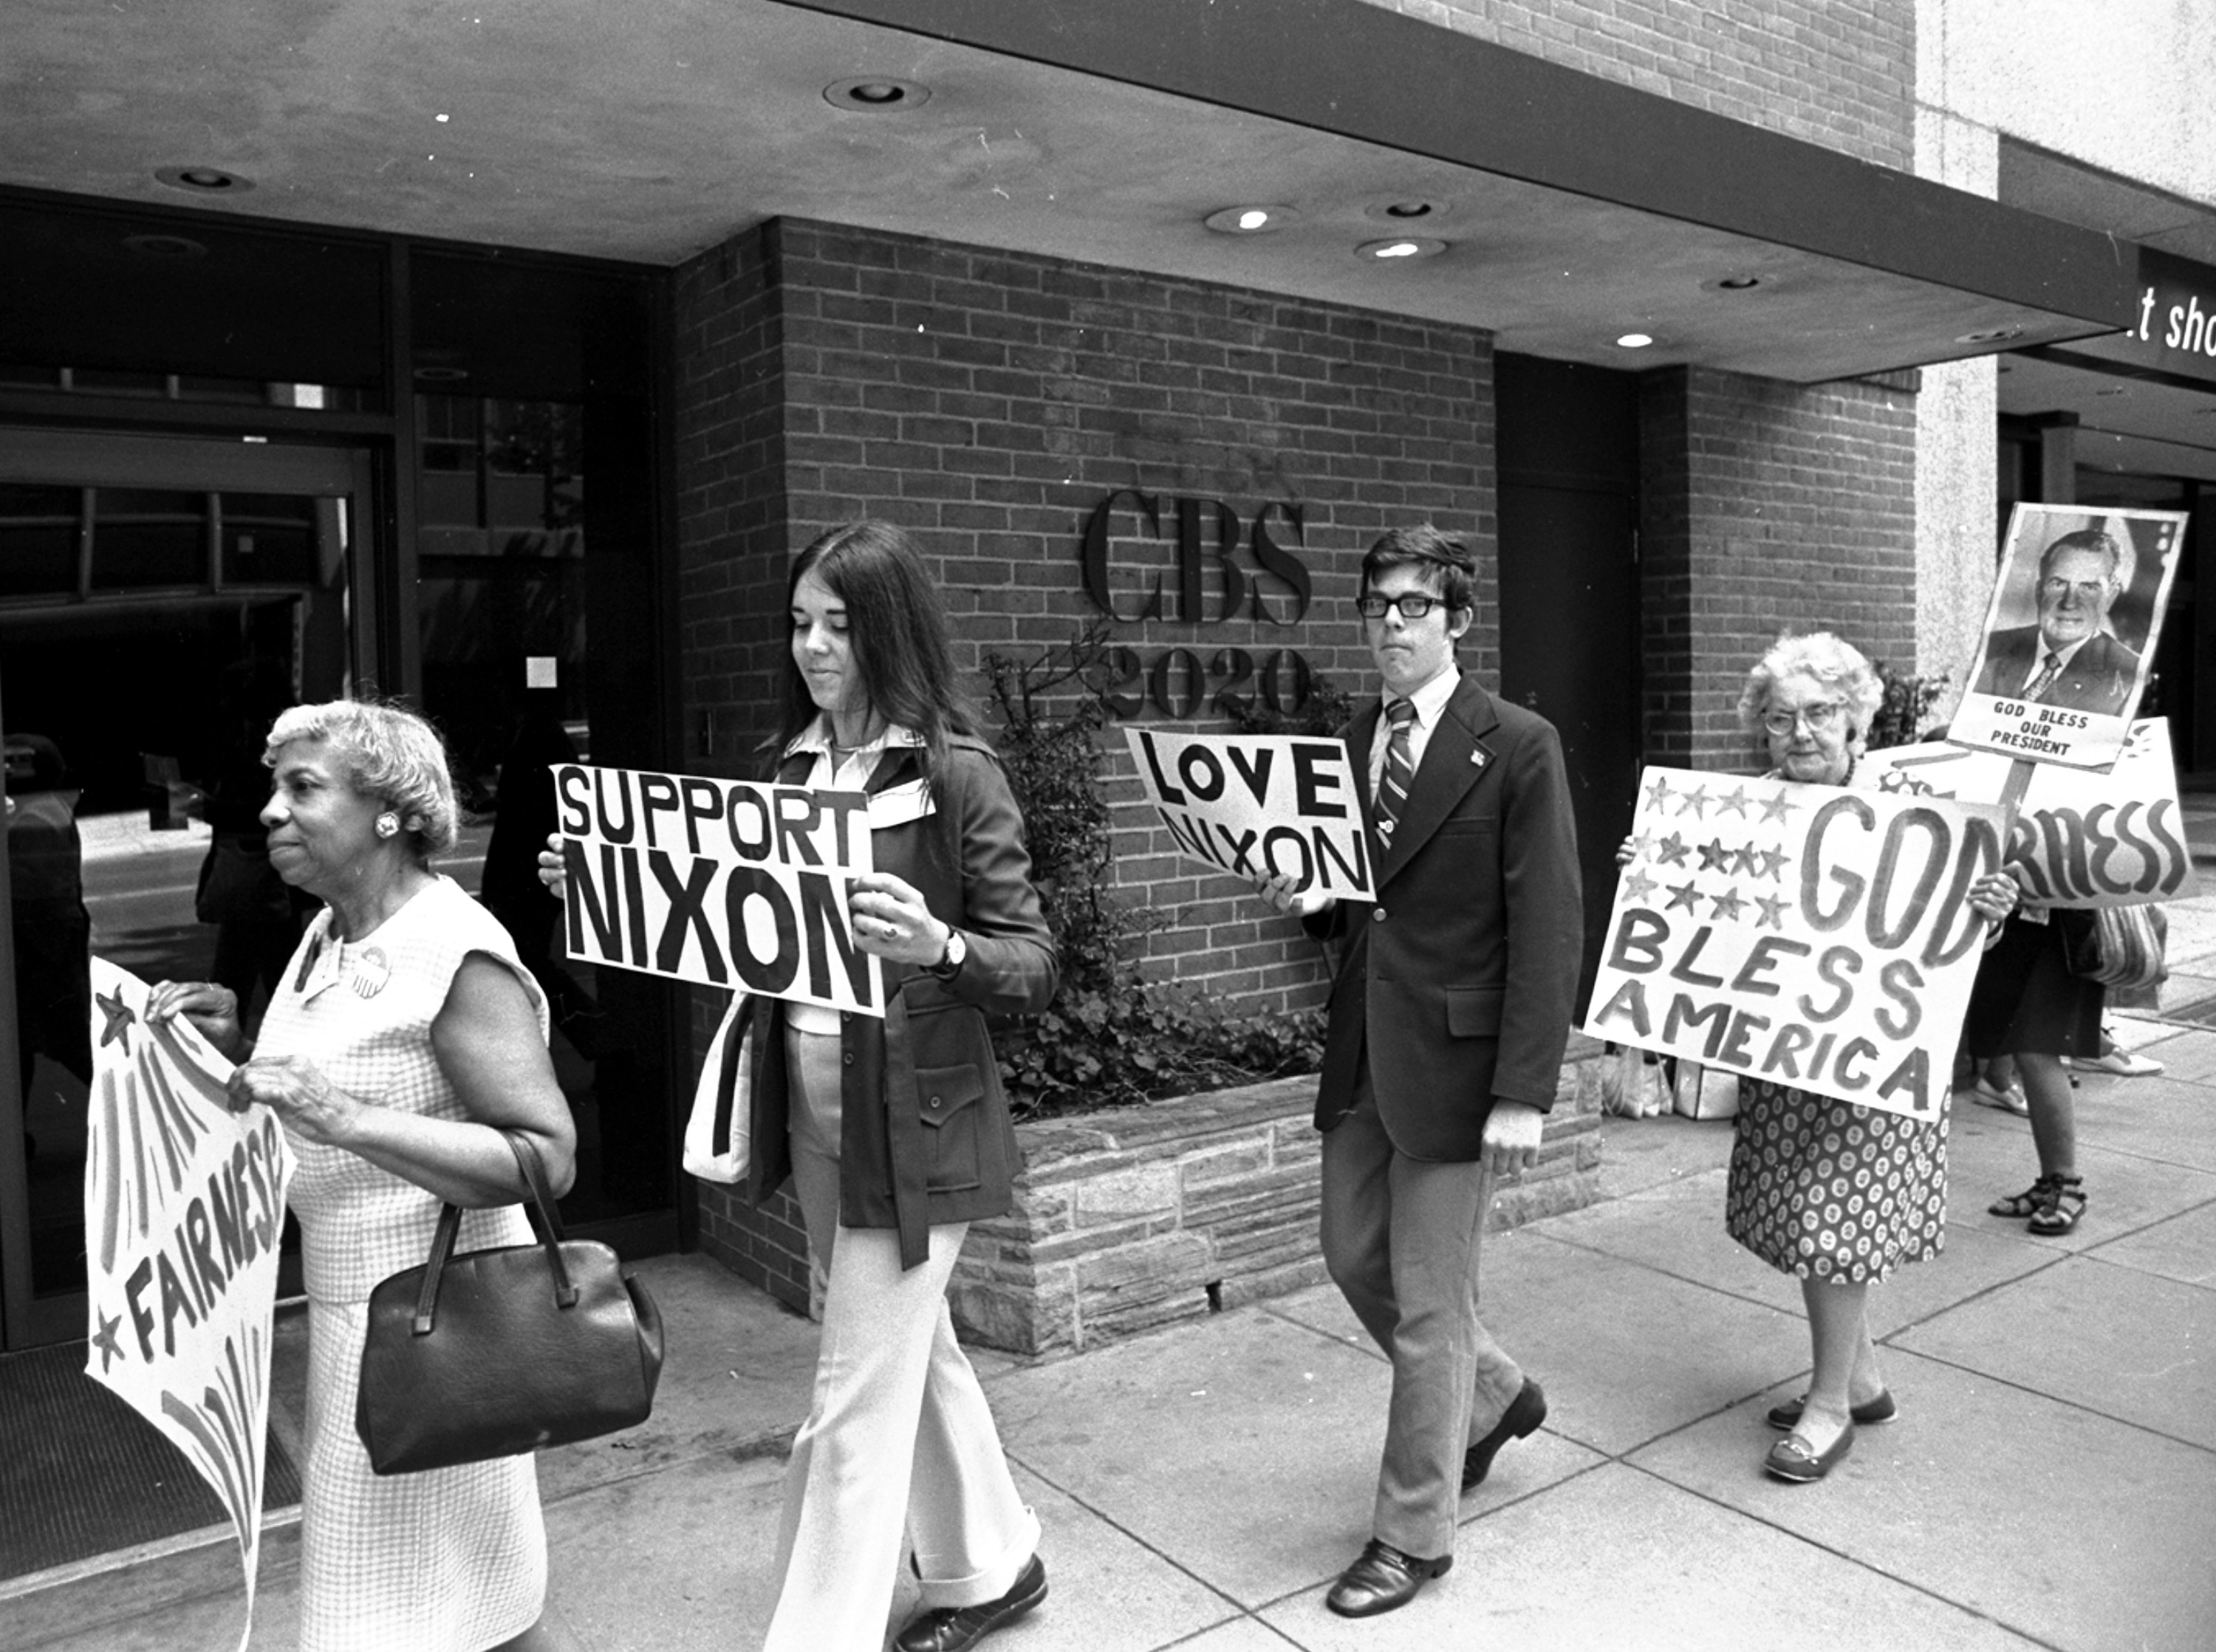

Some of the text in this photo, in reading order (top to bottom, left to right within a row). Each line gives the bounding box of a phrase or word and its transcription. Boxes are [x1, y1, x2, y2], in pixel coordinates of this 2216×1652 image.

[2126, 287, 2155, 340] t
[1084, 489, 1312, 627] CBS
[1098, 646, 1313, 719] 2020
[1994, 702, 2088, 729] GOD BLESS
[1990, 730, 2071, 755] PRESIDENT
[2020, 721, 2051, 738] OUR
[558, 766, 868, 867] SUPPORT
[1139, 732, 1347, 819] LOVE
[1157, 806, 1369, 894] NIXON
[1800, 795, 2001, 969] GOD
[563, 837, 873, 1008] NIXON
[1607, 908, 1925, 1041] BLESS
[1594, 978, 1931, 1111] AMERICA
